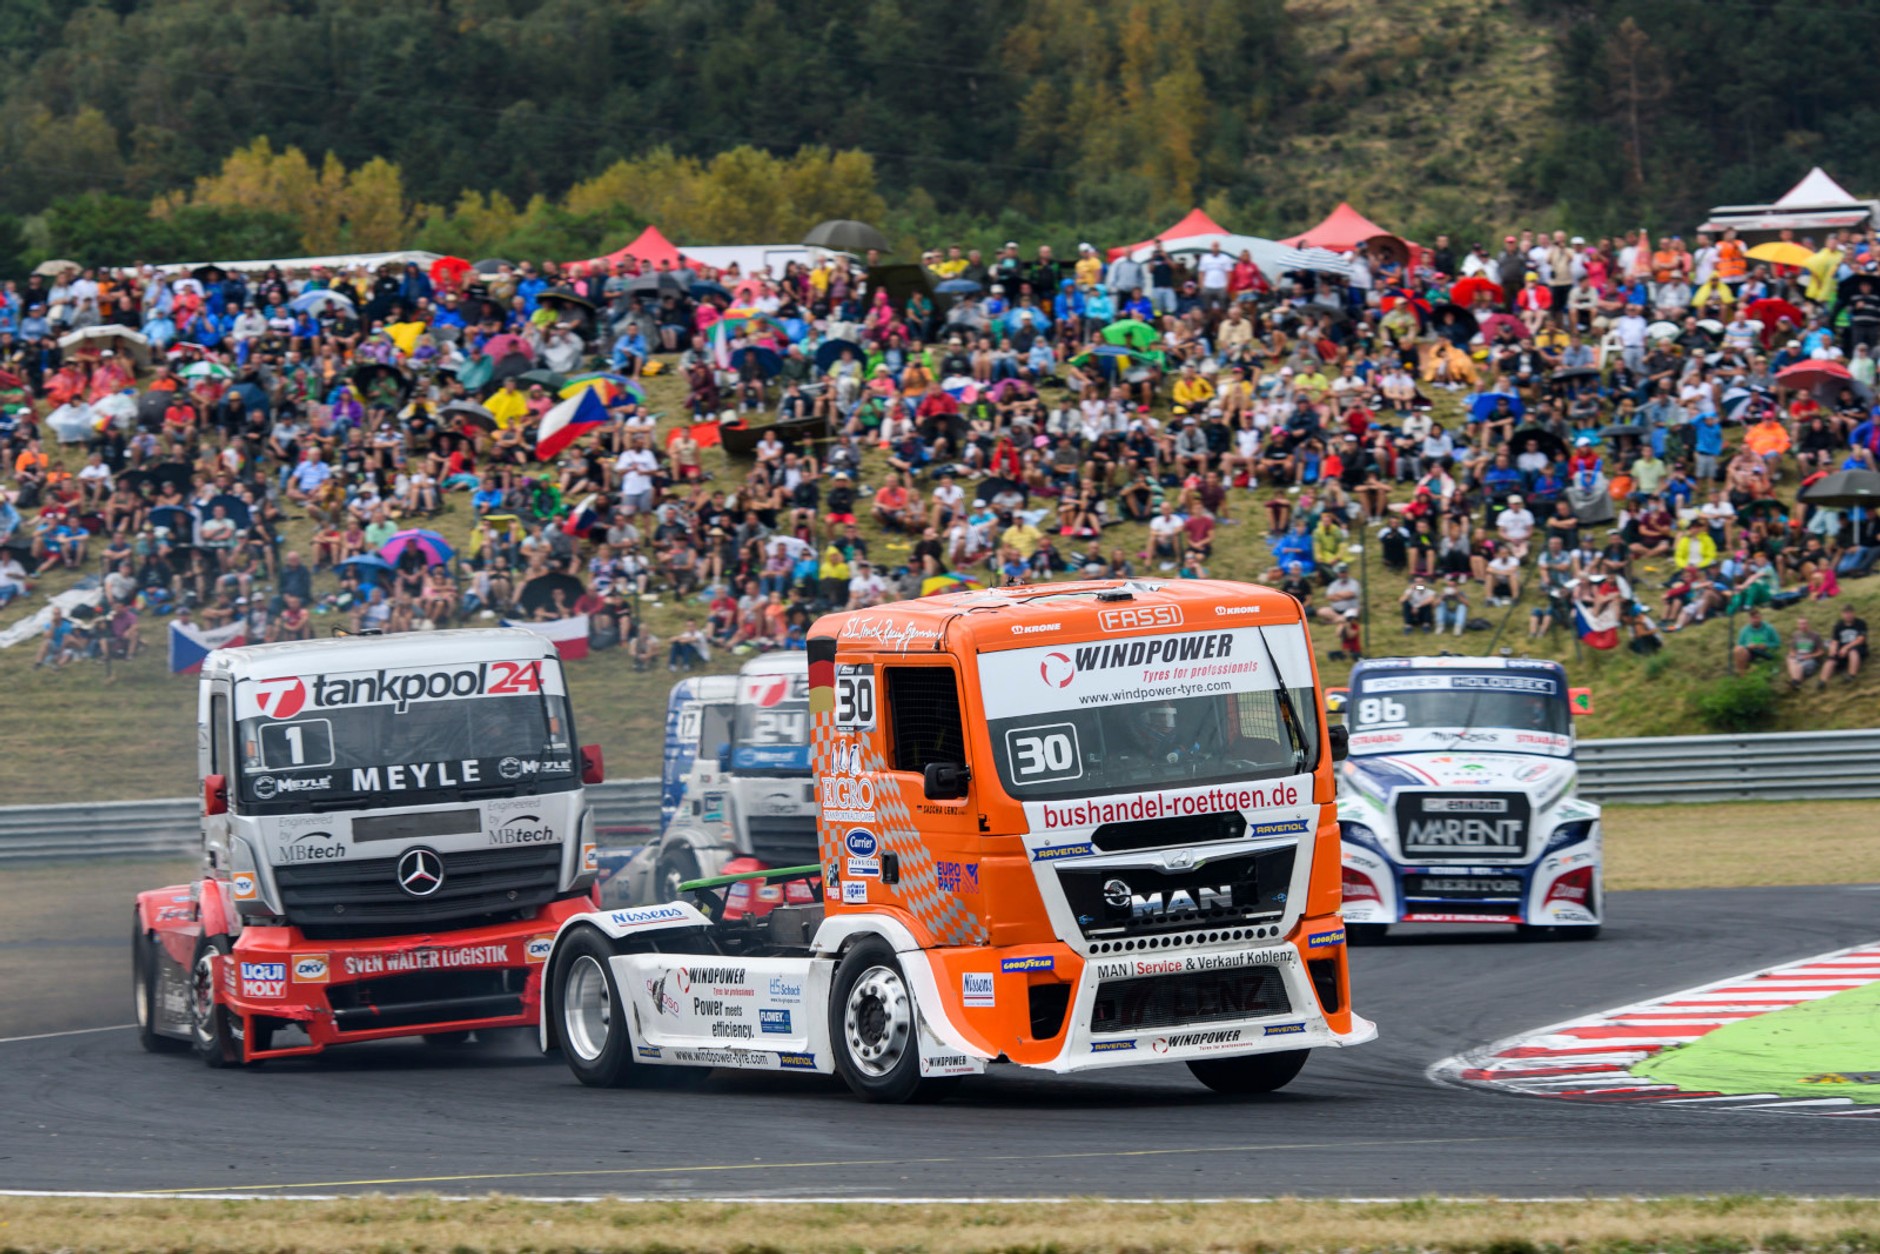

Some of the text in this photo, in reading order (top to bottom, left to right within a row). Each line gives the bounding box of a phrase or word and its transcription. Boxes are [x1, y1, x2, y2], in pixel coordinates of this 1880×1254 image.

[1105, 605, 1179, 629] FASSI
[1226, 605, 1261, 615] KRONE
[1024, 622, 1062, 634] KRONE
[1075, 633, 1233, 672] WINDPOWER
[1143, 660, 1258, 683] Tyres for professionals
[313, 660, 544, 713] tankpool24
[1078, 679, 1232, 705] www.windpower-tyre.com
[838, 679, 873, 722] 30
[752, 712, 804, 743] 24
[285, 726, 304, 764] 1
[1350, 733, 1404, 746] STRABAG
[1515, 733, 1569, 747] STRABAG
[1015, 733, 1073, 775] 30
[352, 759, 481, 792] MEYLE
[488, 800, 541, 813] Engineered
[1043, 781, 1299, 829] bushandel-roettgen.de
[278, 814, 334, 829] Engineered
[1256, 822, 1305, 836] RAVENOL
[488, 825, 554, 845] MBtech
[850, 836, 873, 849] Carrier
[279, 843, 347, 862] MBtech
[1038, 845, 1090, 858] RAVENOL
[937, 862, 961, 877] EURO
[938, 876, 961, 893] PART
[1421, 879, 1522, 892] MERITOR
[1131, 884, 1233, 917] MAN
[612, 905, 684, 924] Nissens
[298, 963, 325, 974] DKV
[345, 956, 384, 975] SVEN
[441, 944, 509, 967] LOGISTIK
[1002, 958, 1052, 970] GOODYEAR
[1097, 964, 1128, 979] MAN
[1136, 960, 1183, 976] Service
[1185, 957, 1196, 971] &
[1197, 953, 1245, 970] Verkauf
[1247, 949, 1293, 965] Koblenz
[241, 963, 285, 980] LIQUI
[689, 967, 746, 985] WINDPOWER
[243, 980, 284, 997] MOLY
[963, 974, 993, 993] Nissens
[693, 996, 743, 1017] Power meets
[712, 1020, 755, 1041] efficiency.
[1266, 1024, 1303, 1034] RAVENOL
[1094, 1042, 1134, 1052] RAVENOL
[1167, 1029, 1242, 1048] WINDPOWER
[675, 1050, 769, 1067] www.windpower-tyre.com
[929, 1054, 967, 1066] WINDPOWER
